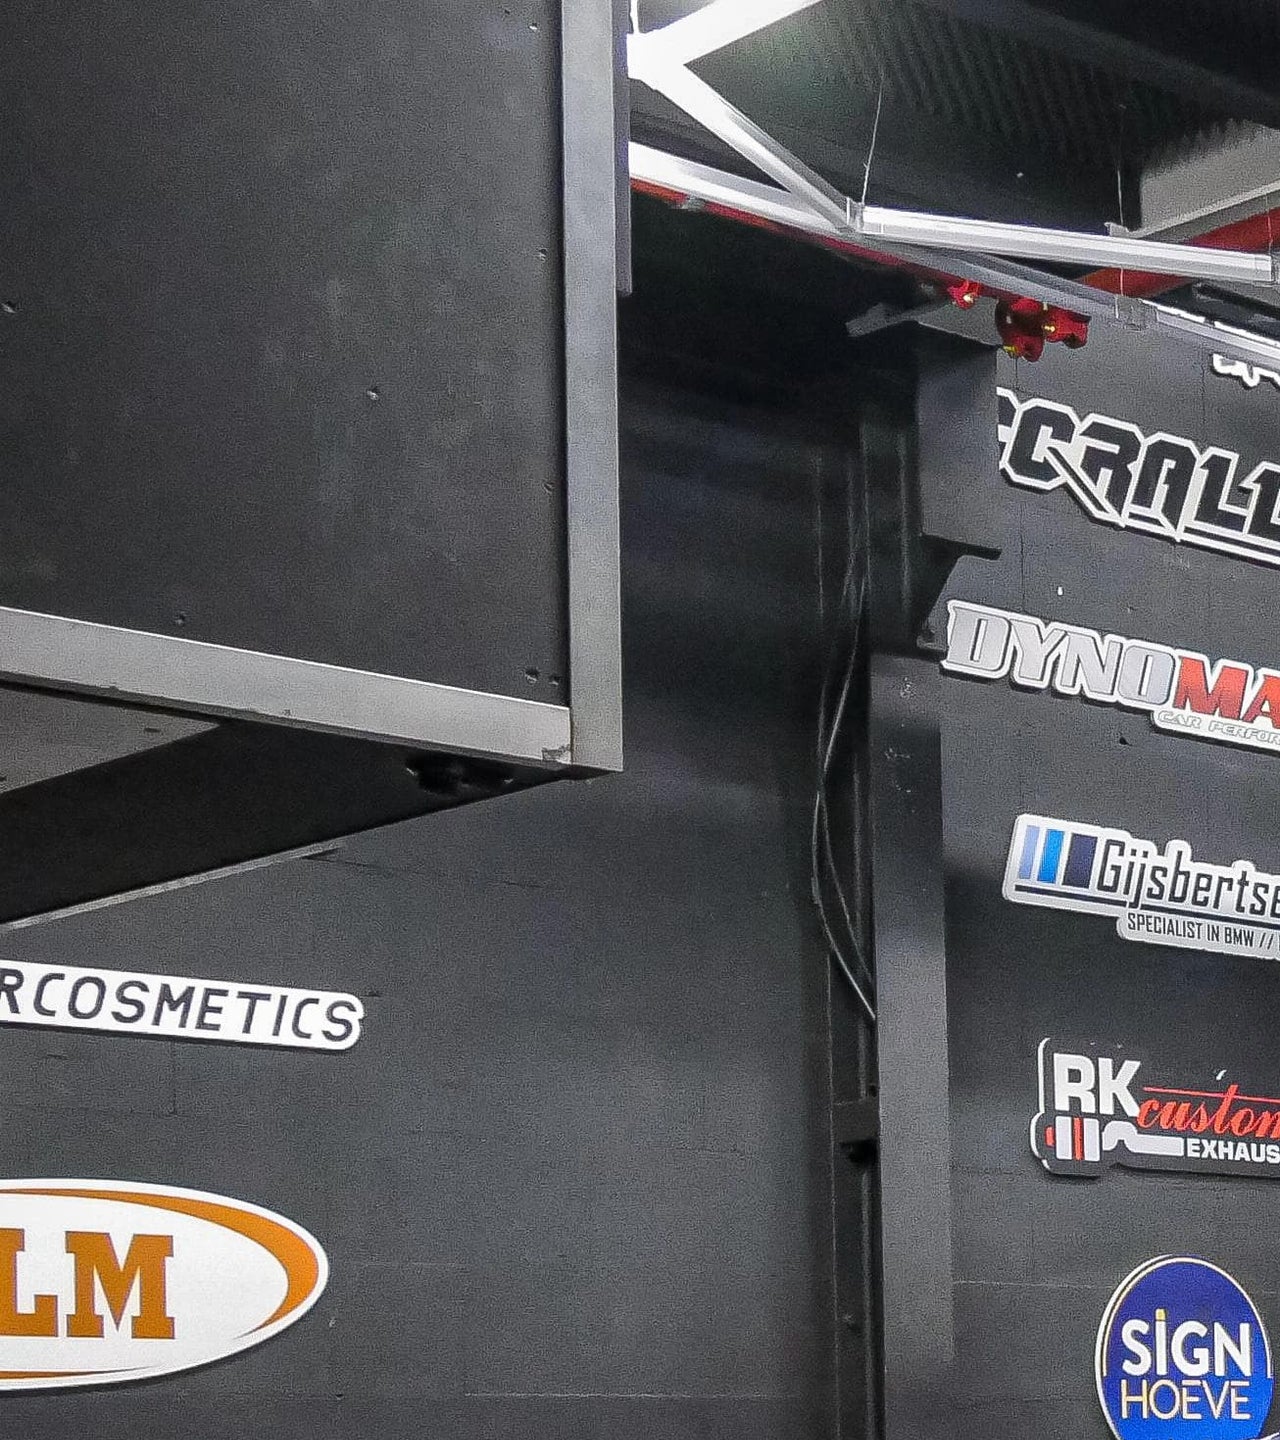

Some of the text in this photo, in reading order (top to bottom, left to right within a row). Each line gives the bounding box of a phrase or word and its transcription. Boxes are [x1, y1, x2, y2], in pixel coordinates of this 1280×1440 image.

[1158, 709, 1202, 729] CAR
[1127, 912, 1203, 941] SPECIALIST
[1207, 923, 1220, 943] IN
[1224, 926, 1255, 948] BMW
[0, 967, 359, 1042] RCOSMETICS
[1053, 1052, 1142, 1118] RK
[1120, 1379, 1252, 1421] HOEVE
